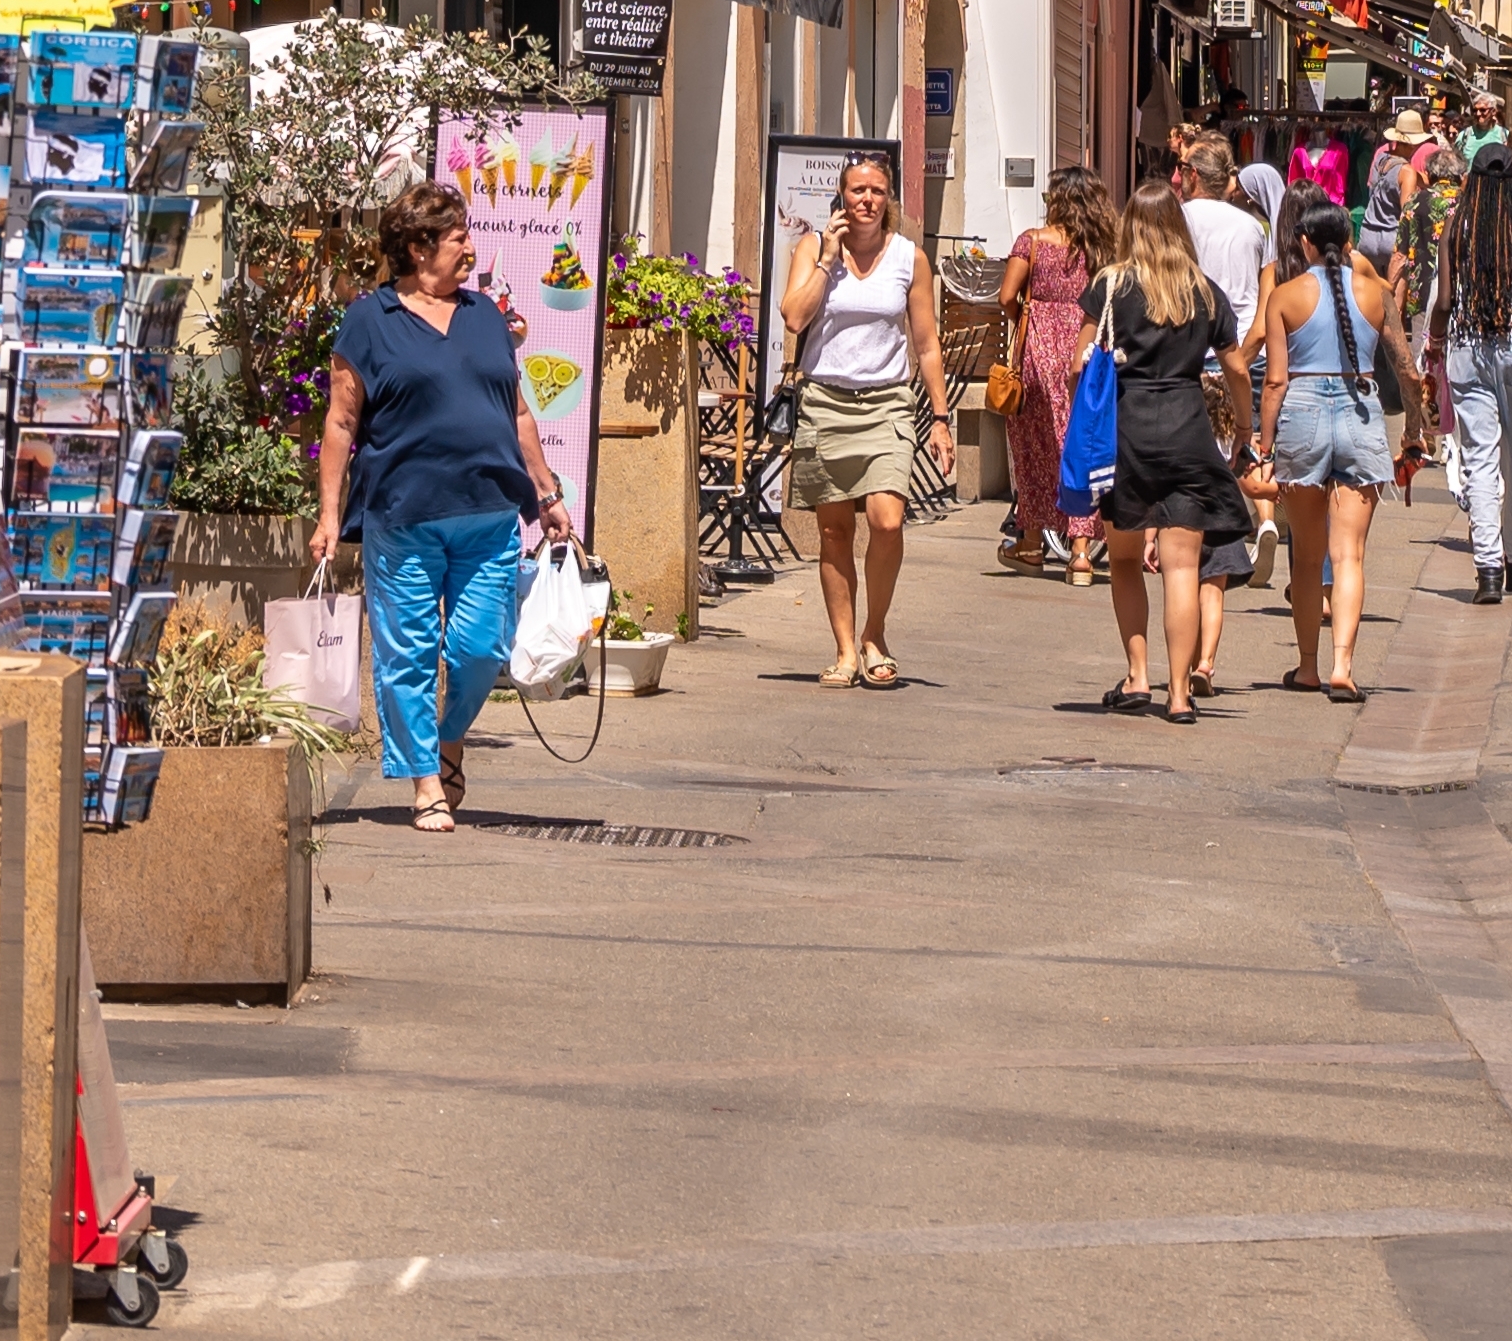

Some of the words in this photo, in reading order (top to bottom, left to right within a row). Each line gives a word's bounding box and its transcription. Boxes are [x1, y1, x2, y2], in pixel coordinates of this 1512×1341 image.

[605, 2, 618, 14] et
[619, 1, 668, 18] science,
[585, 17, 619, 31] entre
[621, 16, 664, 33] réalité
[46, 35, 134, 49] CORSICA
[594, 32, 607, 45] et
[609, 31, 655, 49] théâtre
[590, 62, 603, 72] DU
[605, 63, 616, 73] 29
[616, 64, 637, 75] JUIN
[638, 66, 652, 76] AU
[591, 76, 636, 88] EPTEMBRE
[638, 78, 659, 89] 2024
[799, 172, 809, 185] À
[810, 175, 825, 185] LA
[473, 177, 498, 196] les
[501, 179, 563, 199] cornets
[519, 219, 563, 239] glacé
[565, 219, 582, 237] 0%
[540, 434, 566, 446] ella
